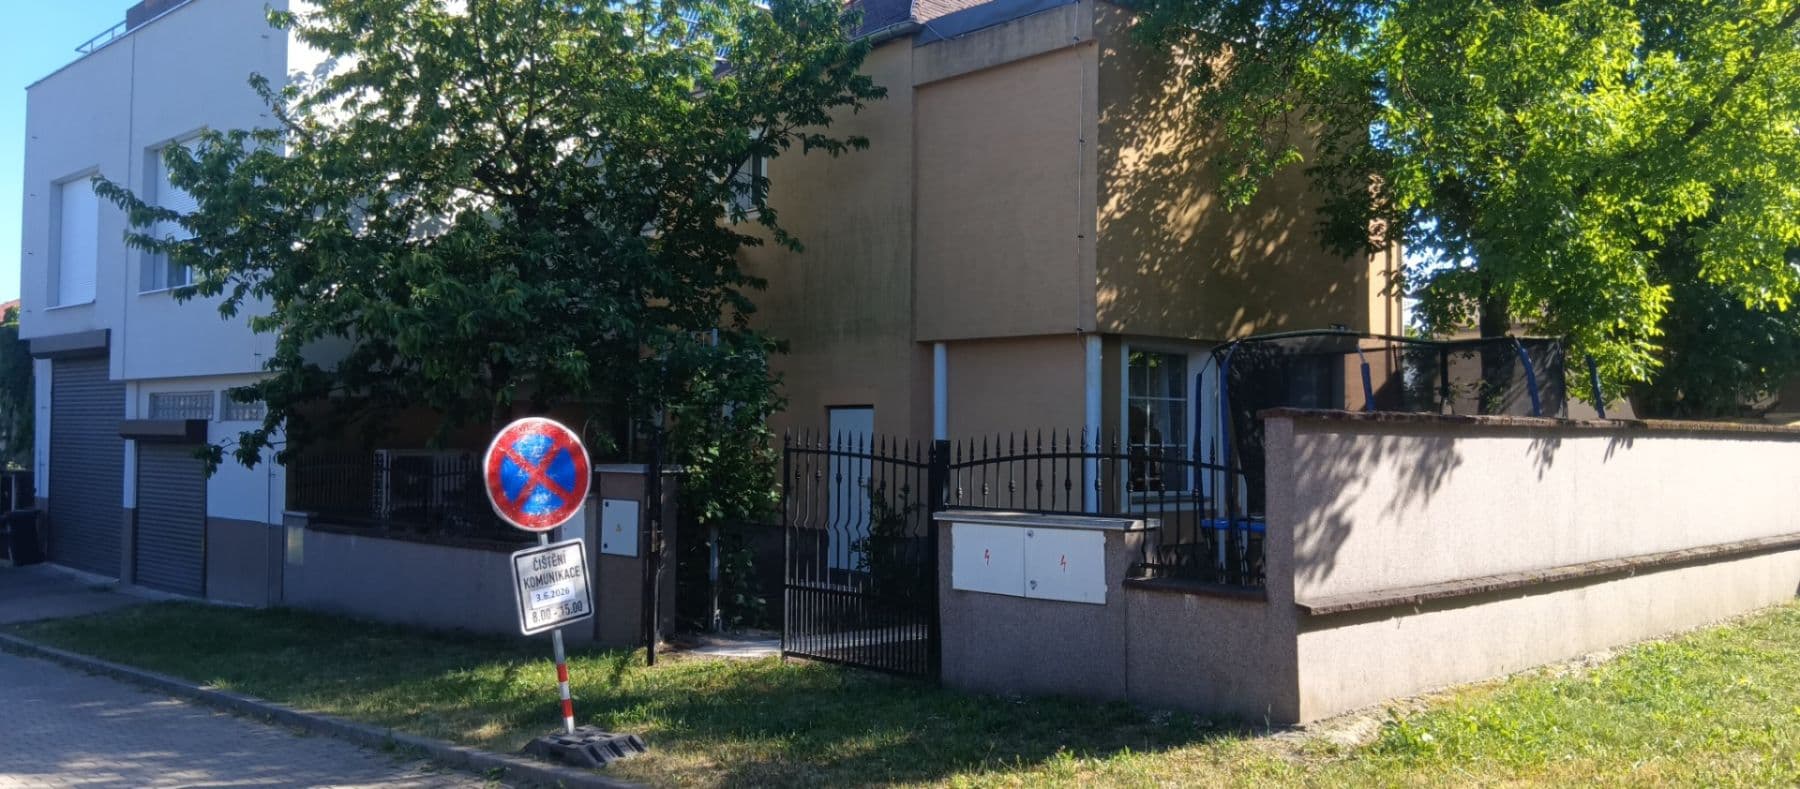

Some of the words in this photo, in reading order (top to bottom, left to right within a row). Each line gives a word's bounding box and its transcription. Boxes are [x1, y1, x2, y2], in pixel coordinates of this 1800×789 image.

[532, 551, 567, 571] ČIŠTĚNÍ
[523, 565, 580, 590] KOMUNIKACE
[532, 608, 552, 623] 8.00
[560, 600, 583, 616] 15.00
